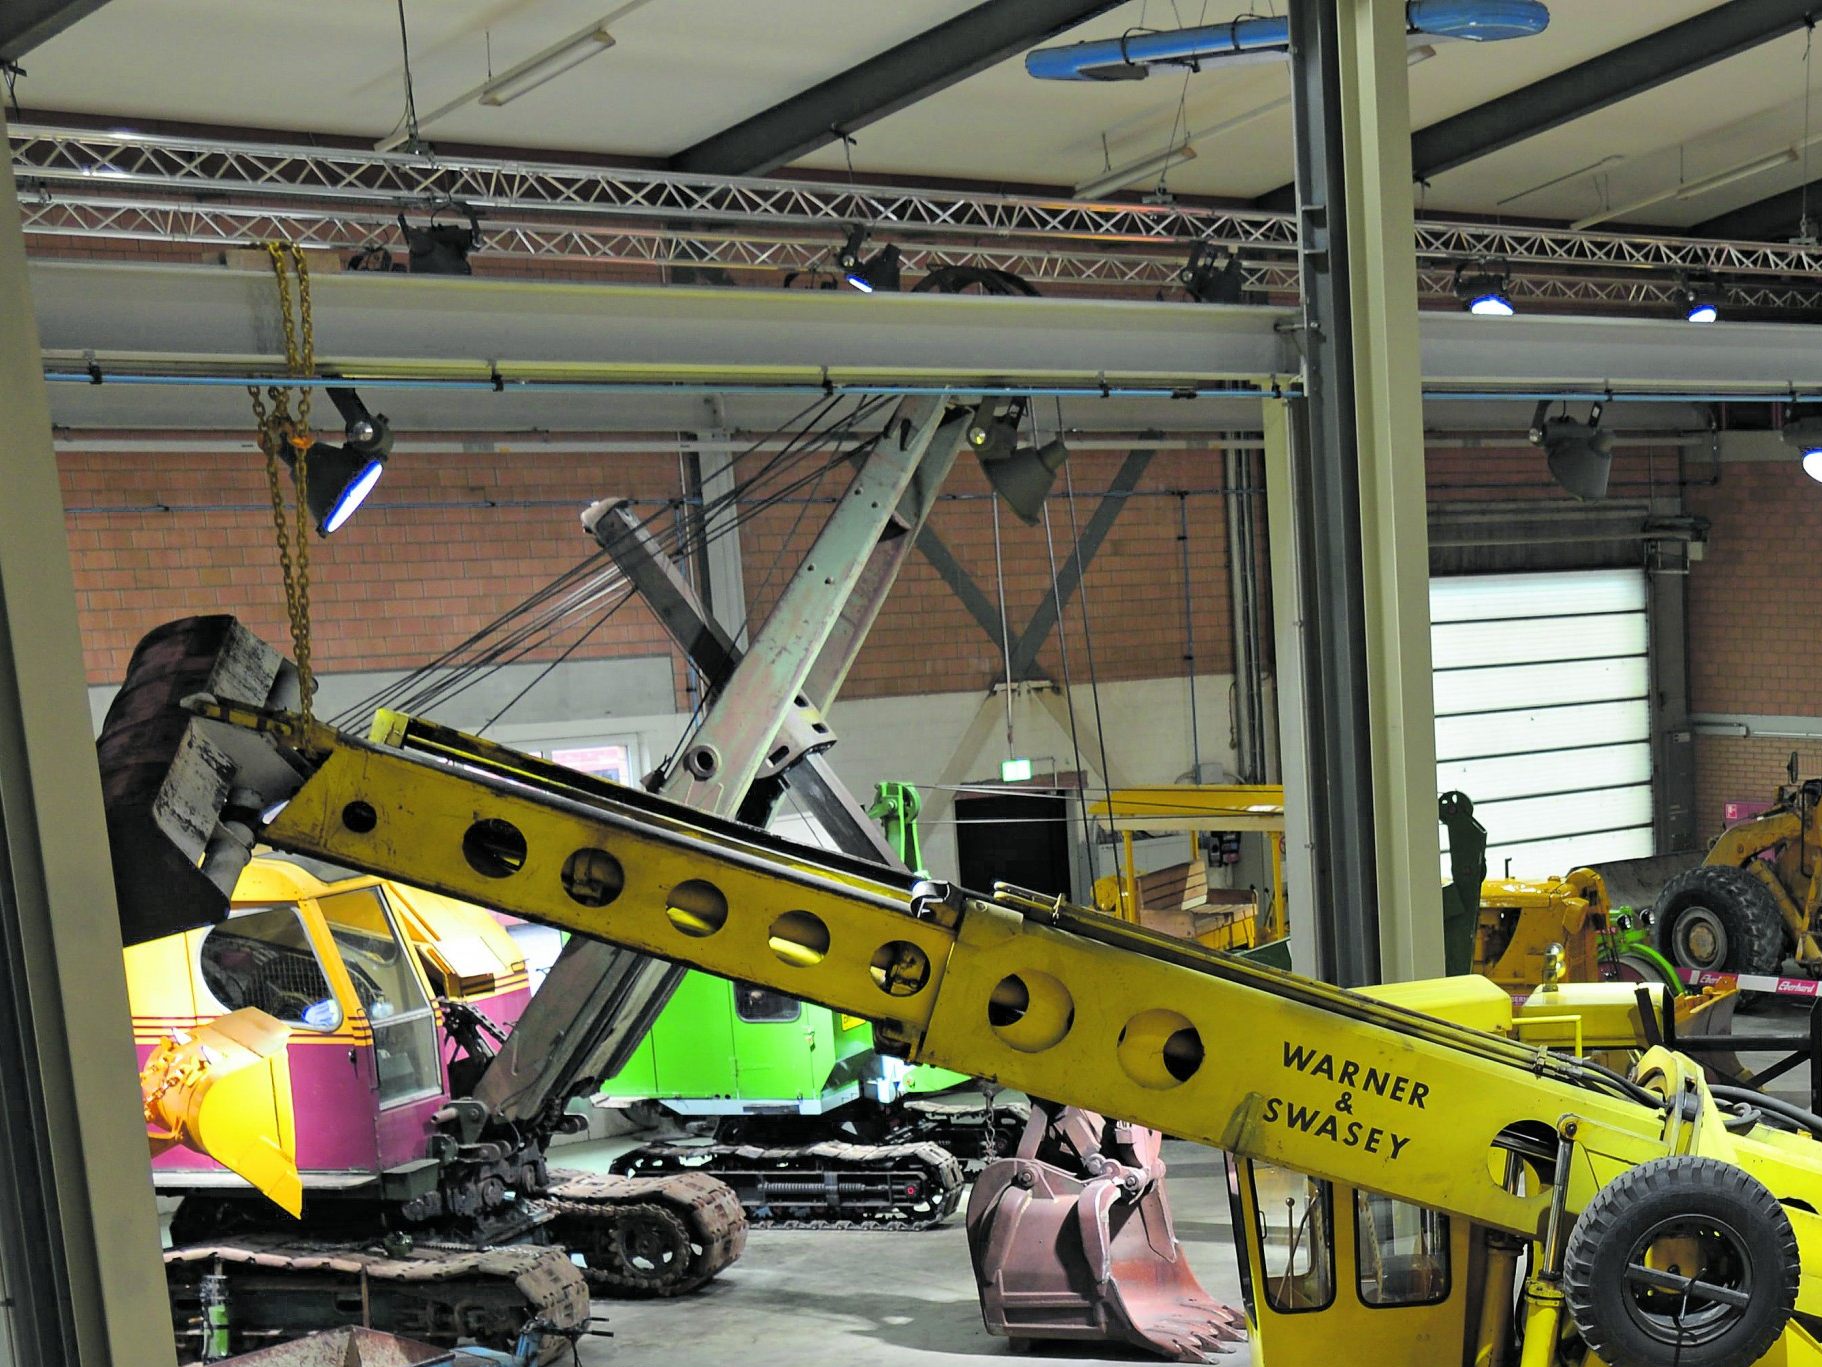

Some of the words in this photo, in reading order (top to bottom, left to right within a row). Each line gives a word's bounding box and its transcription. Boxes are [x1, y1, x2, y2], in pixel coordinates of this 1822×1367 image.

[1778, 981, 1815, 993] Eberhard
[1283, 1040, 1430, 1110] WARNER
[1335, 1091, 1353, 1115] &
[1262, 1097, 1411, 1160] SWASEY
